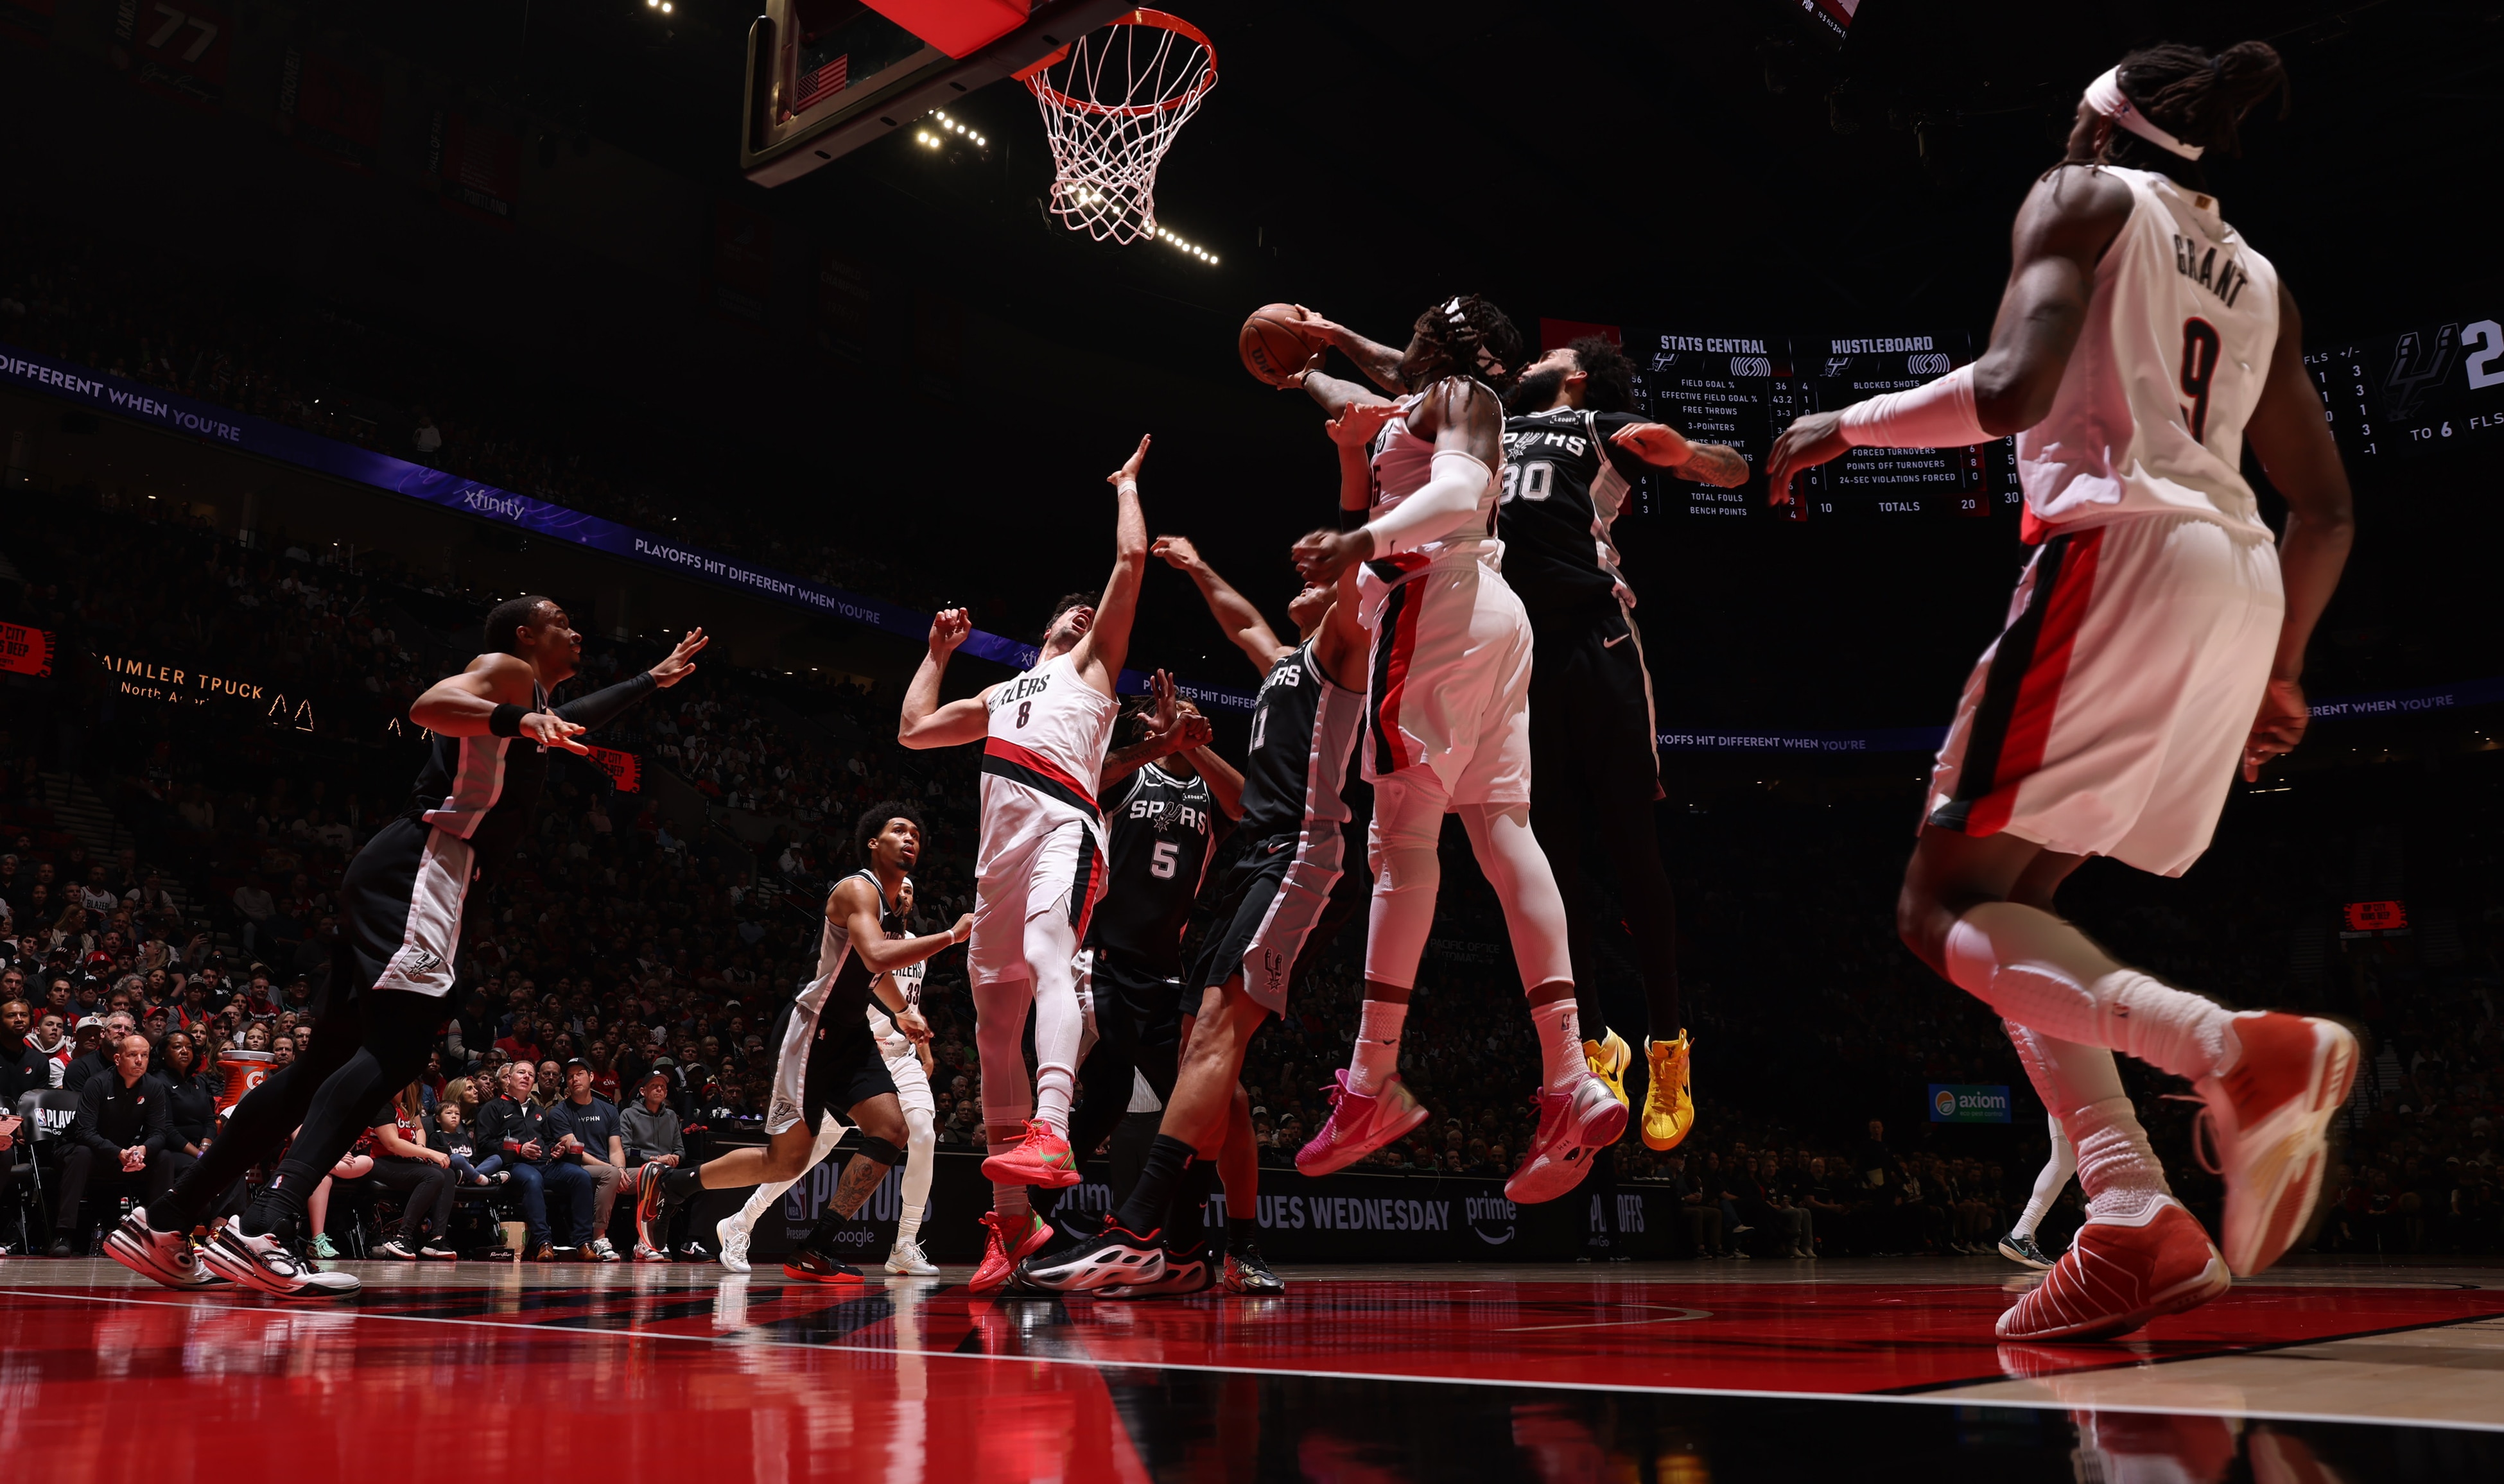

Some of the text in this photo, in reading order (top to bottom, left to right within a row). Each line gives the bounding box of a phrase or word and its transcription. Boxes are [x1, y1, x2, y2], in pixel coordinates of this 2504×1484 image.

[2174, 234, 2248, 309] GRANT
[1660, 334, 1768, 354] STATS CENTRAL
[1831, 336, 1934, 354] HUSTLEBOARD
[2304, 352, 2329, 365] FLS
[2180, 316, 2221, 446] 9
[2319, 365, 2361, 383] 1 3
[1681, 379, 1702, 388] FIELD
[1705, 380, 1726, 388] GOAL
[1802, 380, 1920, 390] 4 BLOCKED SHOTS
[0, 354, 241, 443] DIFFERENT WHEN YOU'RE
[1633, 389, 1793, 404] 5.6 EFFECTIVE FIELD GOAL % 43.2
[1804, 395, 1809, 404] 1
[2322, 384, 2365, 403] 1 3
[1682, 405, 1703, 414] FREE
[1705, 406, 1737, 415] THROWS
[2360, 404, 2367, 416] 1
[1688, 422, 1735, 431] 3-POINTERS
[2361, 424, 2370, 436] 3
[2410, 427, 2432, 442] TO
[2440, 421, 2453, 438] 6
[1721, 440, 1745, 448] PAINT
[1852, 448, 1885, 456] FORCED
[1886, 447, 1936, 456] TURNOVERS
[2005, 435, 2013, 447] 3
[2363, 442, 2376, 455] -1
[1847, 462, 1875, 470] POINTS
[1878, 461, 1894, 470] OFF
[1897, 460, 1945, 469] TURNOVERS
[1970, 458, 1977, 467] 8
[2007, 454, 2015, 465] 5
[1500, 460, 1556, 506] 30
[1641, 476, 1647, 485] 6
[1811, 472, 2018, 485] 0 24-SEC VIOLATIONS FORCED 0 11
[464, 488, 525, 521] xfinity
[1691, 492, 1715, 501] TOTAL
[1717, 494, 1743, 502] FOULS
[1789, 497, 1795, 505] 3
[1820, 492, 2019, 513] 10 TOTALS 20 30
[1643, 505, 1649, 513] 3
[1690, 506, 1717, 515] BENCH
[1719, 507, 1747, 516] POINTS
[635, 538, 882, 626] PLAYOFFS HIT DIFFERENT WHEN YOU'RE
[6, 625, 27, 643] CITY
[6, 641, 30, 657] DEEP
[121, 681, 161, 700] North
[198, 673, 265, 700] TRUCK
[1200, 689, 1219, 702] HIT
[2352, 700, 2397, 714] WHEN
[2399, 695, 2455, 711] YOU'RE
[1016, 701, 1032, 729] 8
[1656, 734, 1866, 751] YOFFS HIT DIFFERENT WHEN YOU'RE
[607, 752, 622, 764] CITY
[1129, 799, 1207, 836] SPURS
[1149, 839, 1181, 880] 5
[906, 982, 920, 1006] 33
[1959, 1091, 2006, 1109] axiom
[46, 1109, 76, 1129] PLAY
[788, 1206, 799, 1216] NBA
[1309, 1196, 1451, 1232] WEDNESDAY
[1465, 1189, 1517, 1226] prime
[833, 1227, 875, 1248] oogle
